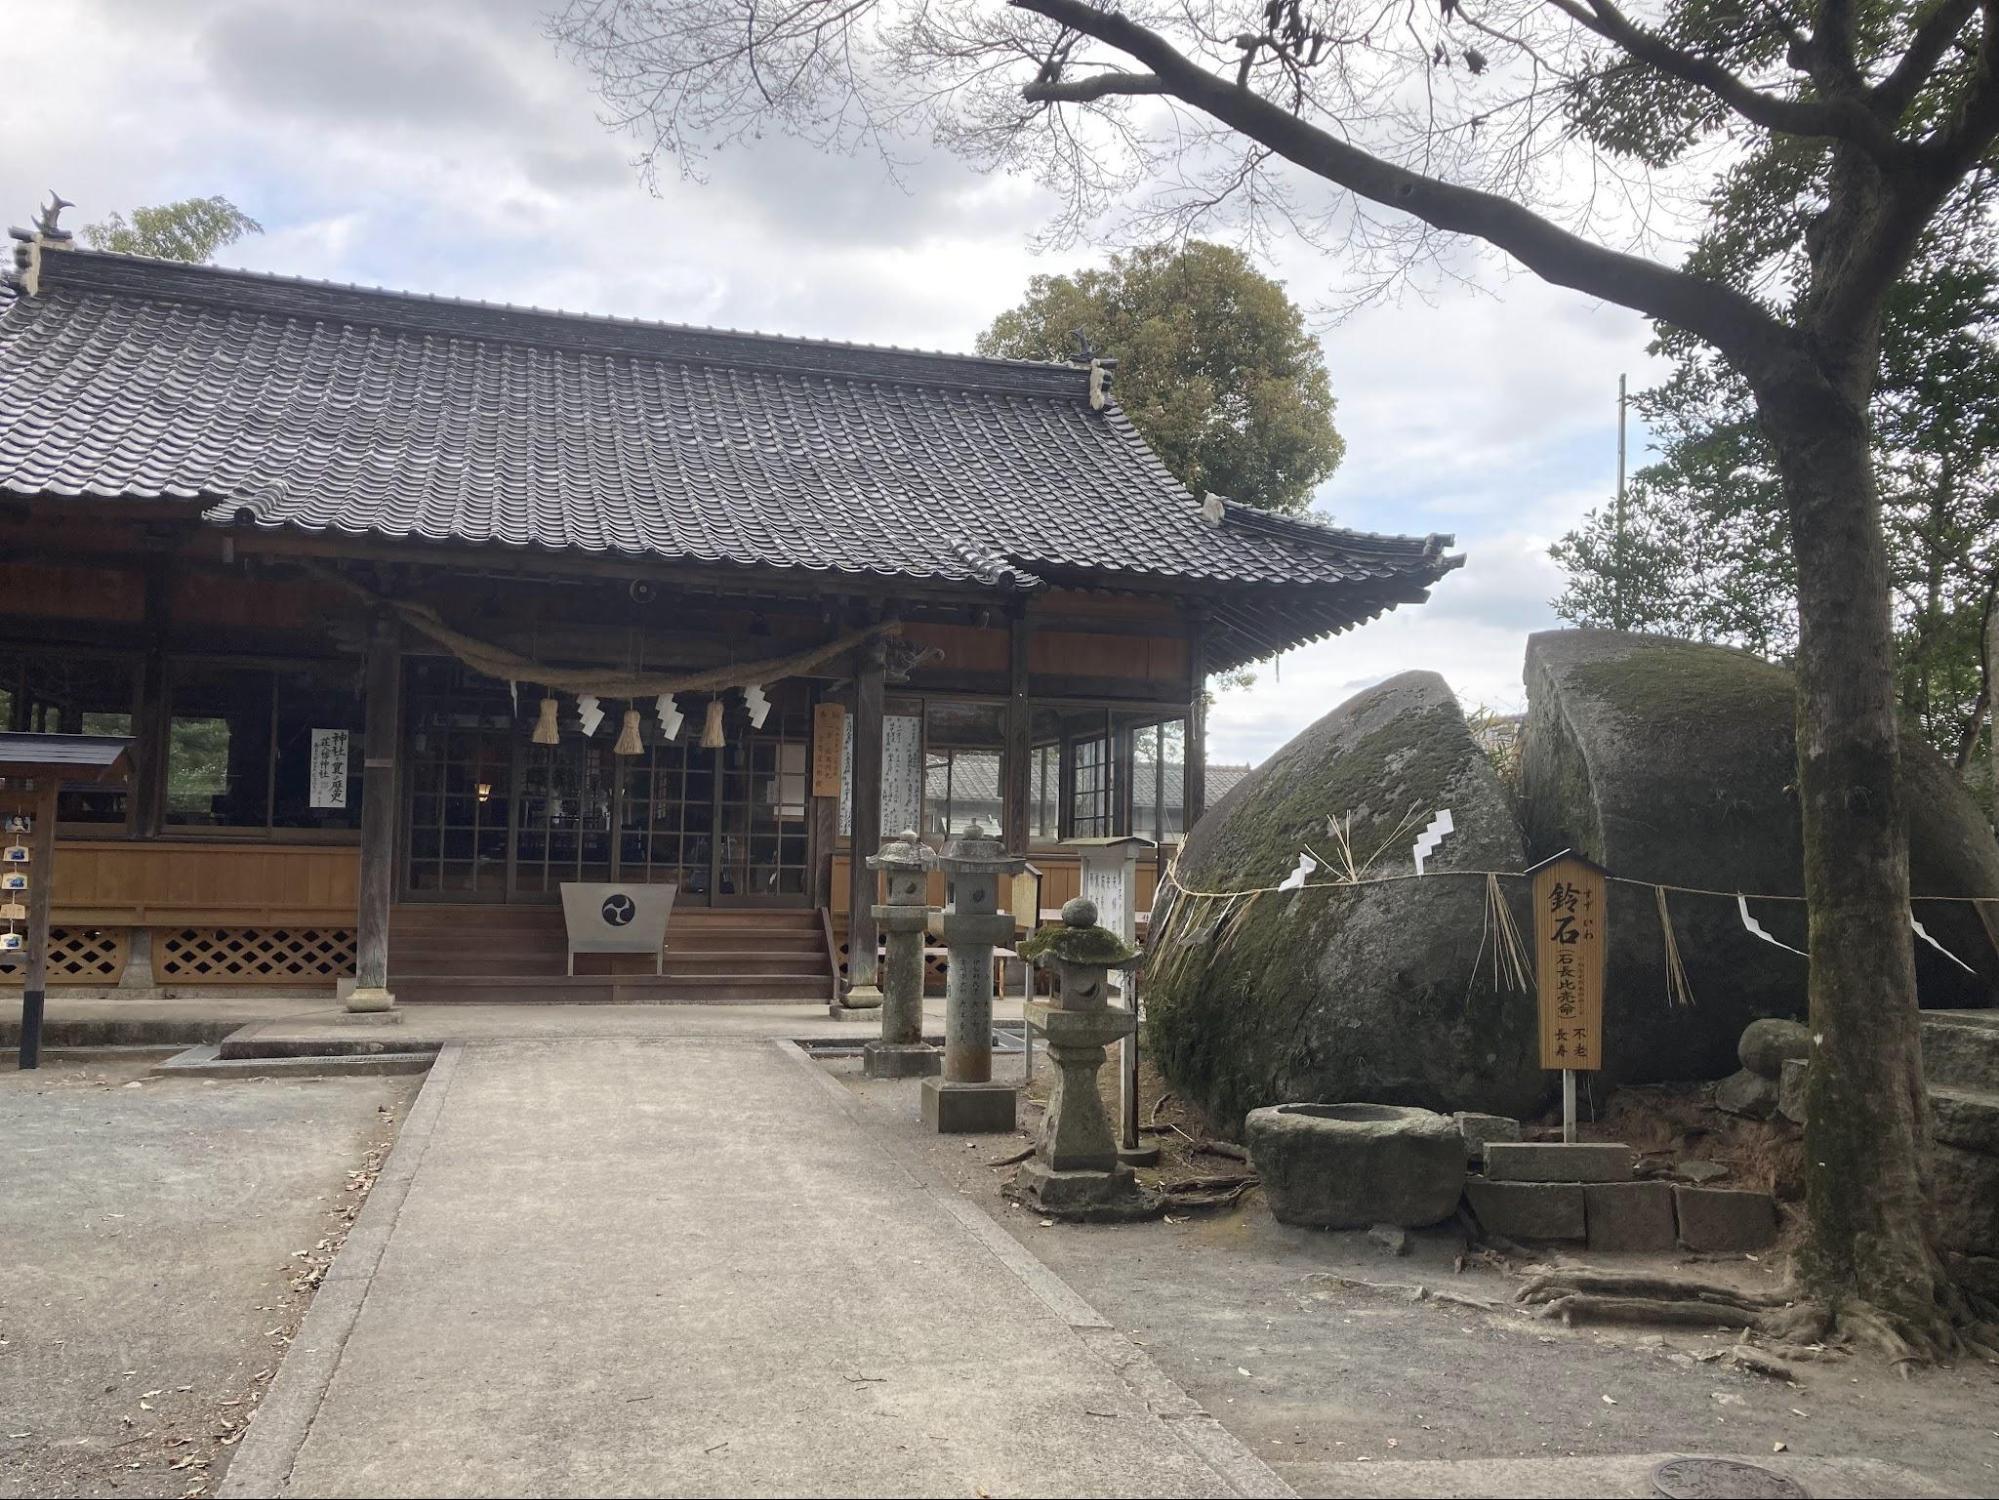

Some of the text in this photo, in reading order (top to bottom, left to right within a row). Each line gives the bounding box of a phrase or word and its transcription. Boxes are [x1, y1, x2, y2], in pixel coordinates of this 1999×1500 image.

[1548, 881, 1582, 946] 鈴石
[1554, 1027, 1569, 1058] 長寿
[1572, 1027, 1588, 1058] 不老
